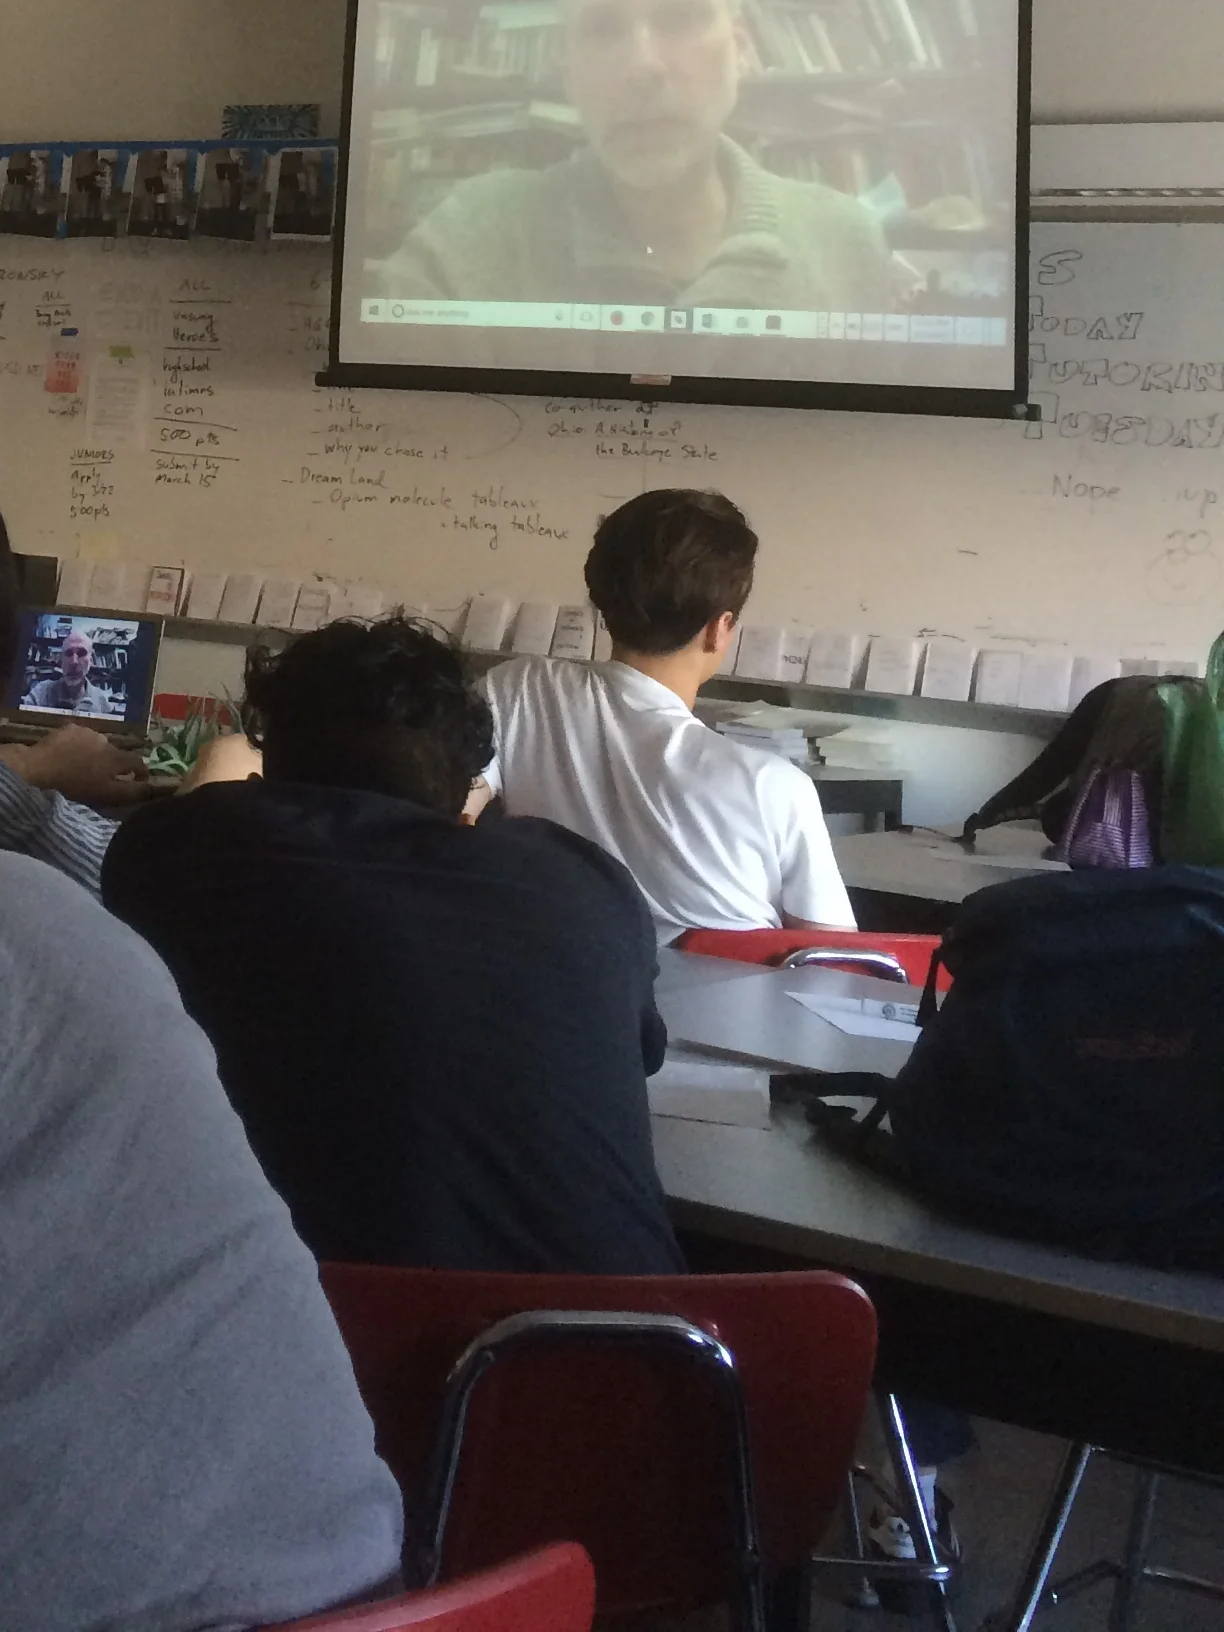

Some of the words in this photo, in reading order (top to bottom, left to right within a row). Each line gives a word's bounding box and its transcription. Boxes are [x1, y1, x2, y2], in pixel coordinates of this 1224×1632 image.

[327, 416, 384, 434] author
[160, 428, 192, 442] 500
[154, 472, 191, 485] March
[300, 466, 343, 485] Dream
[329, 488, 378, 511] Opium
[1052, 473, 1121, 516] Nope
